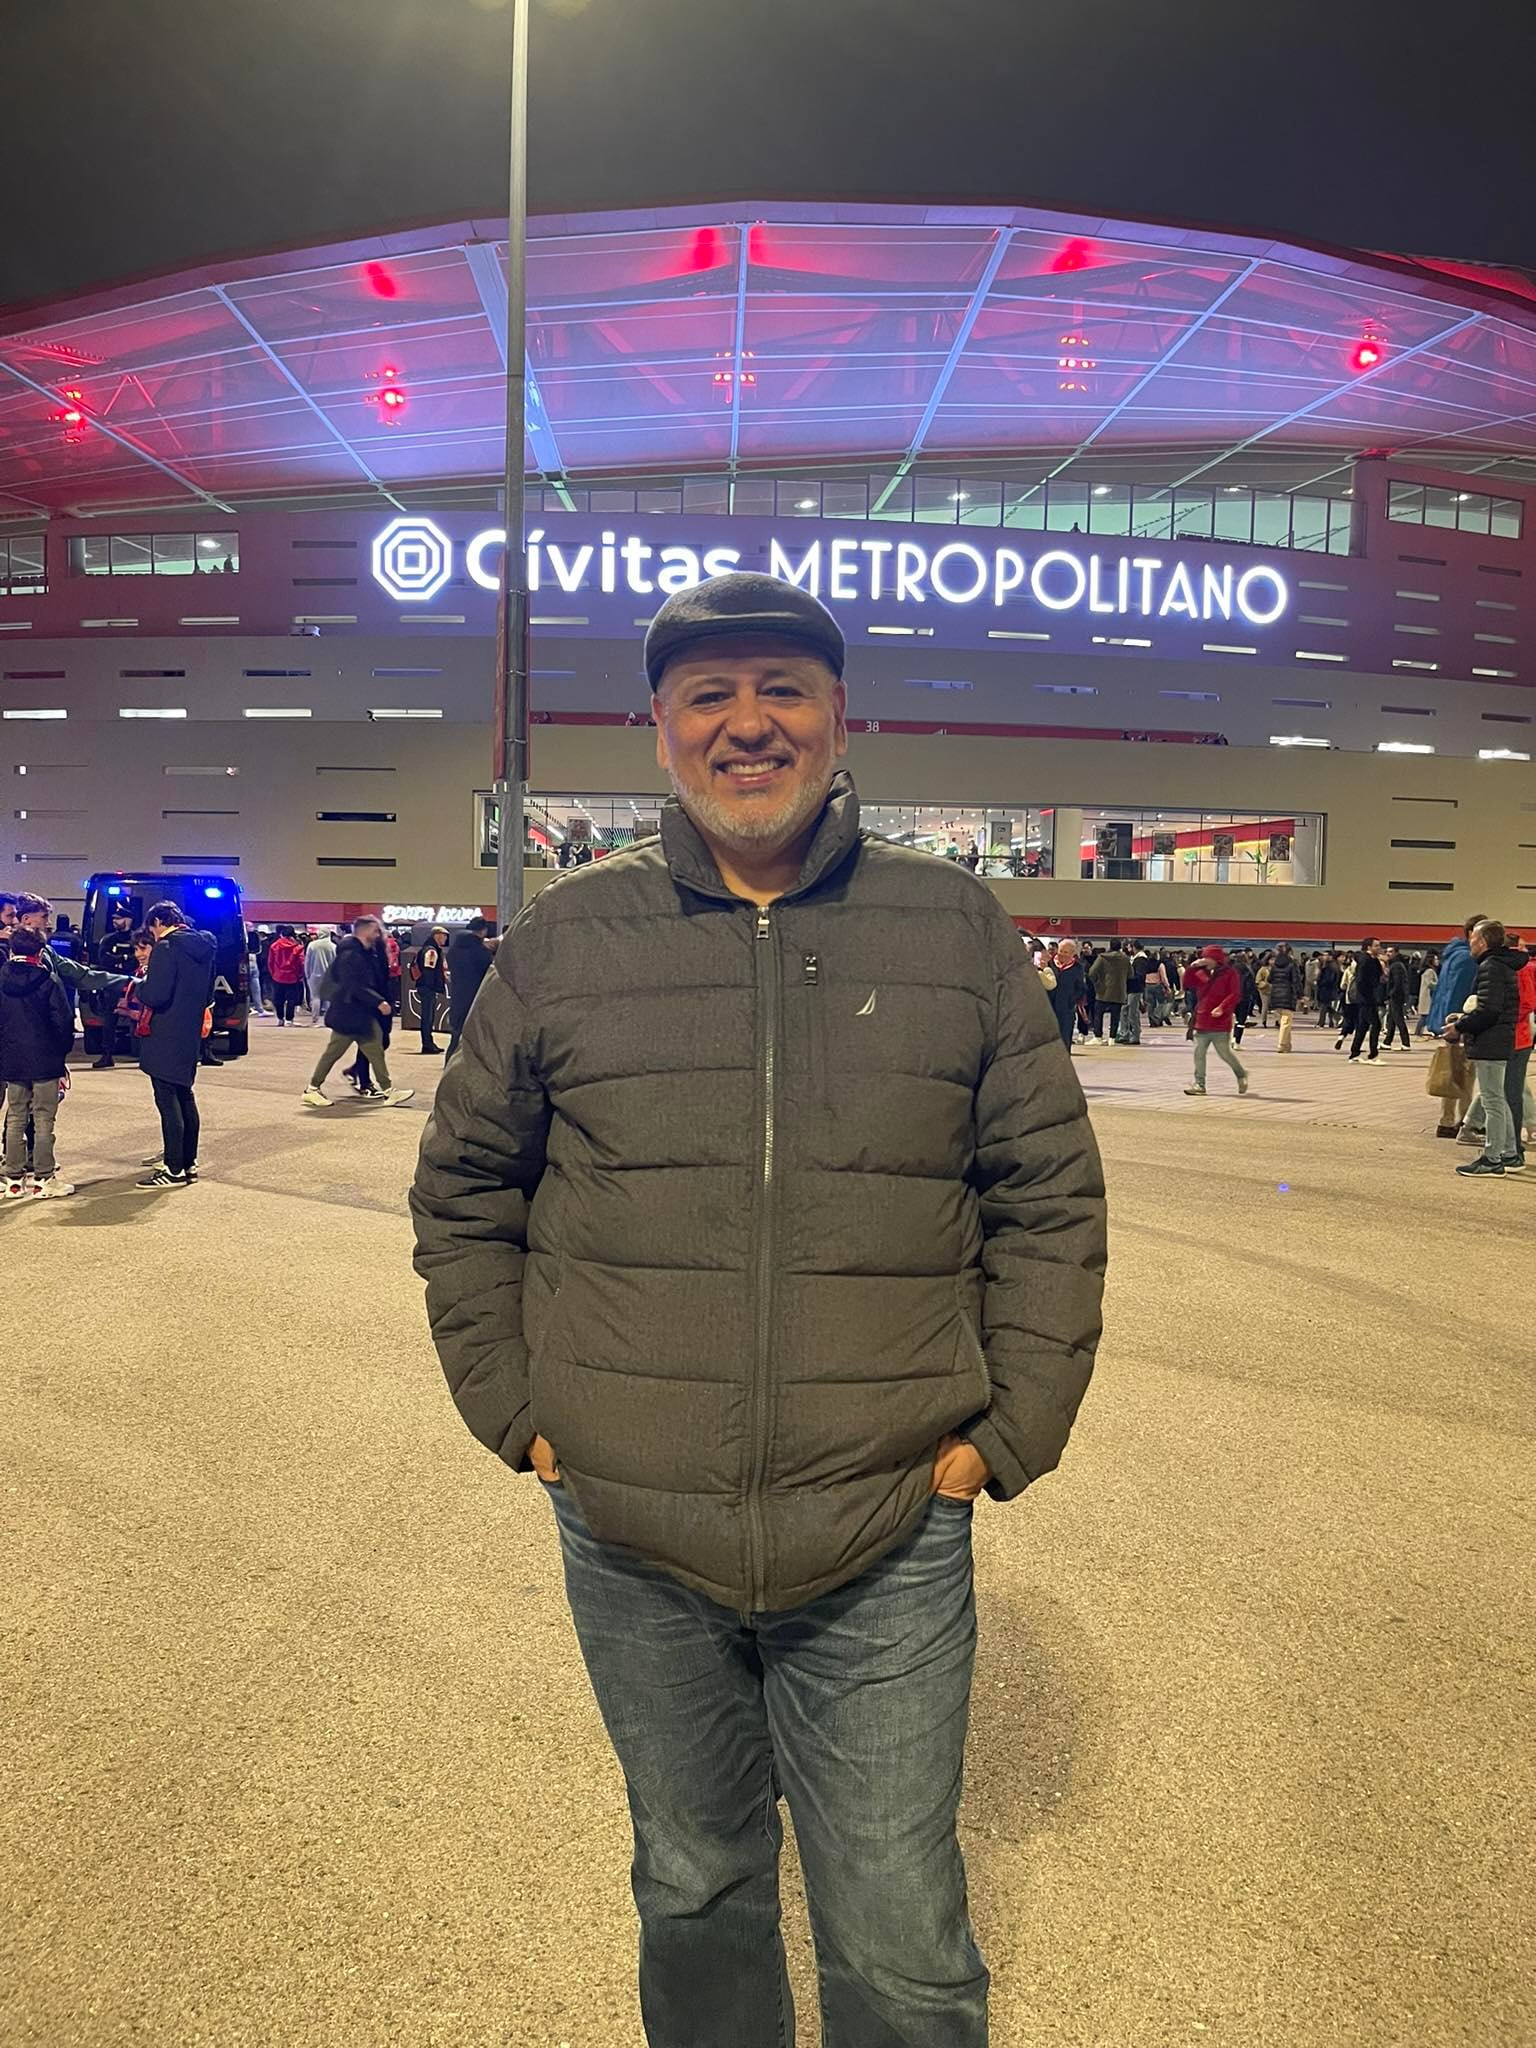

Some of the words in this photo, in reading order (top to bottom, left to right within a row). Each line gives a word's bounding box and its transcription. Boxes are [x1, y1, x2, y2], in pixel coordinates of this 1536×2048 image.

[465, 529, 741, 593] Cívitas
[769, 537, 1288, 625] METROPOLITANO
[865, 720, 880, 733] 38
